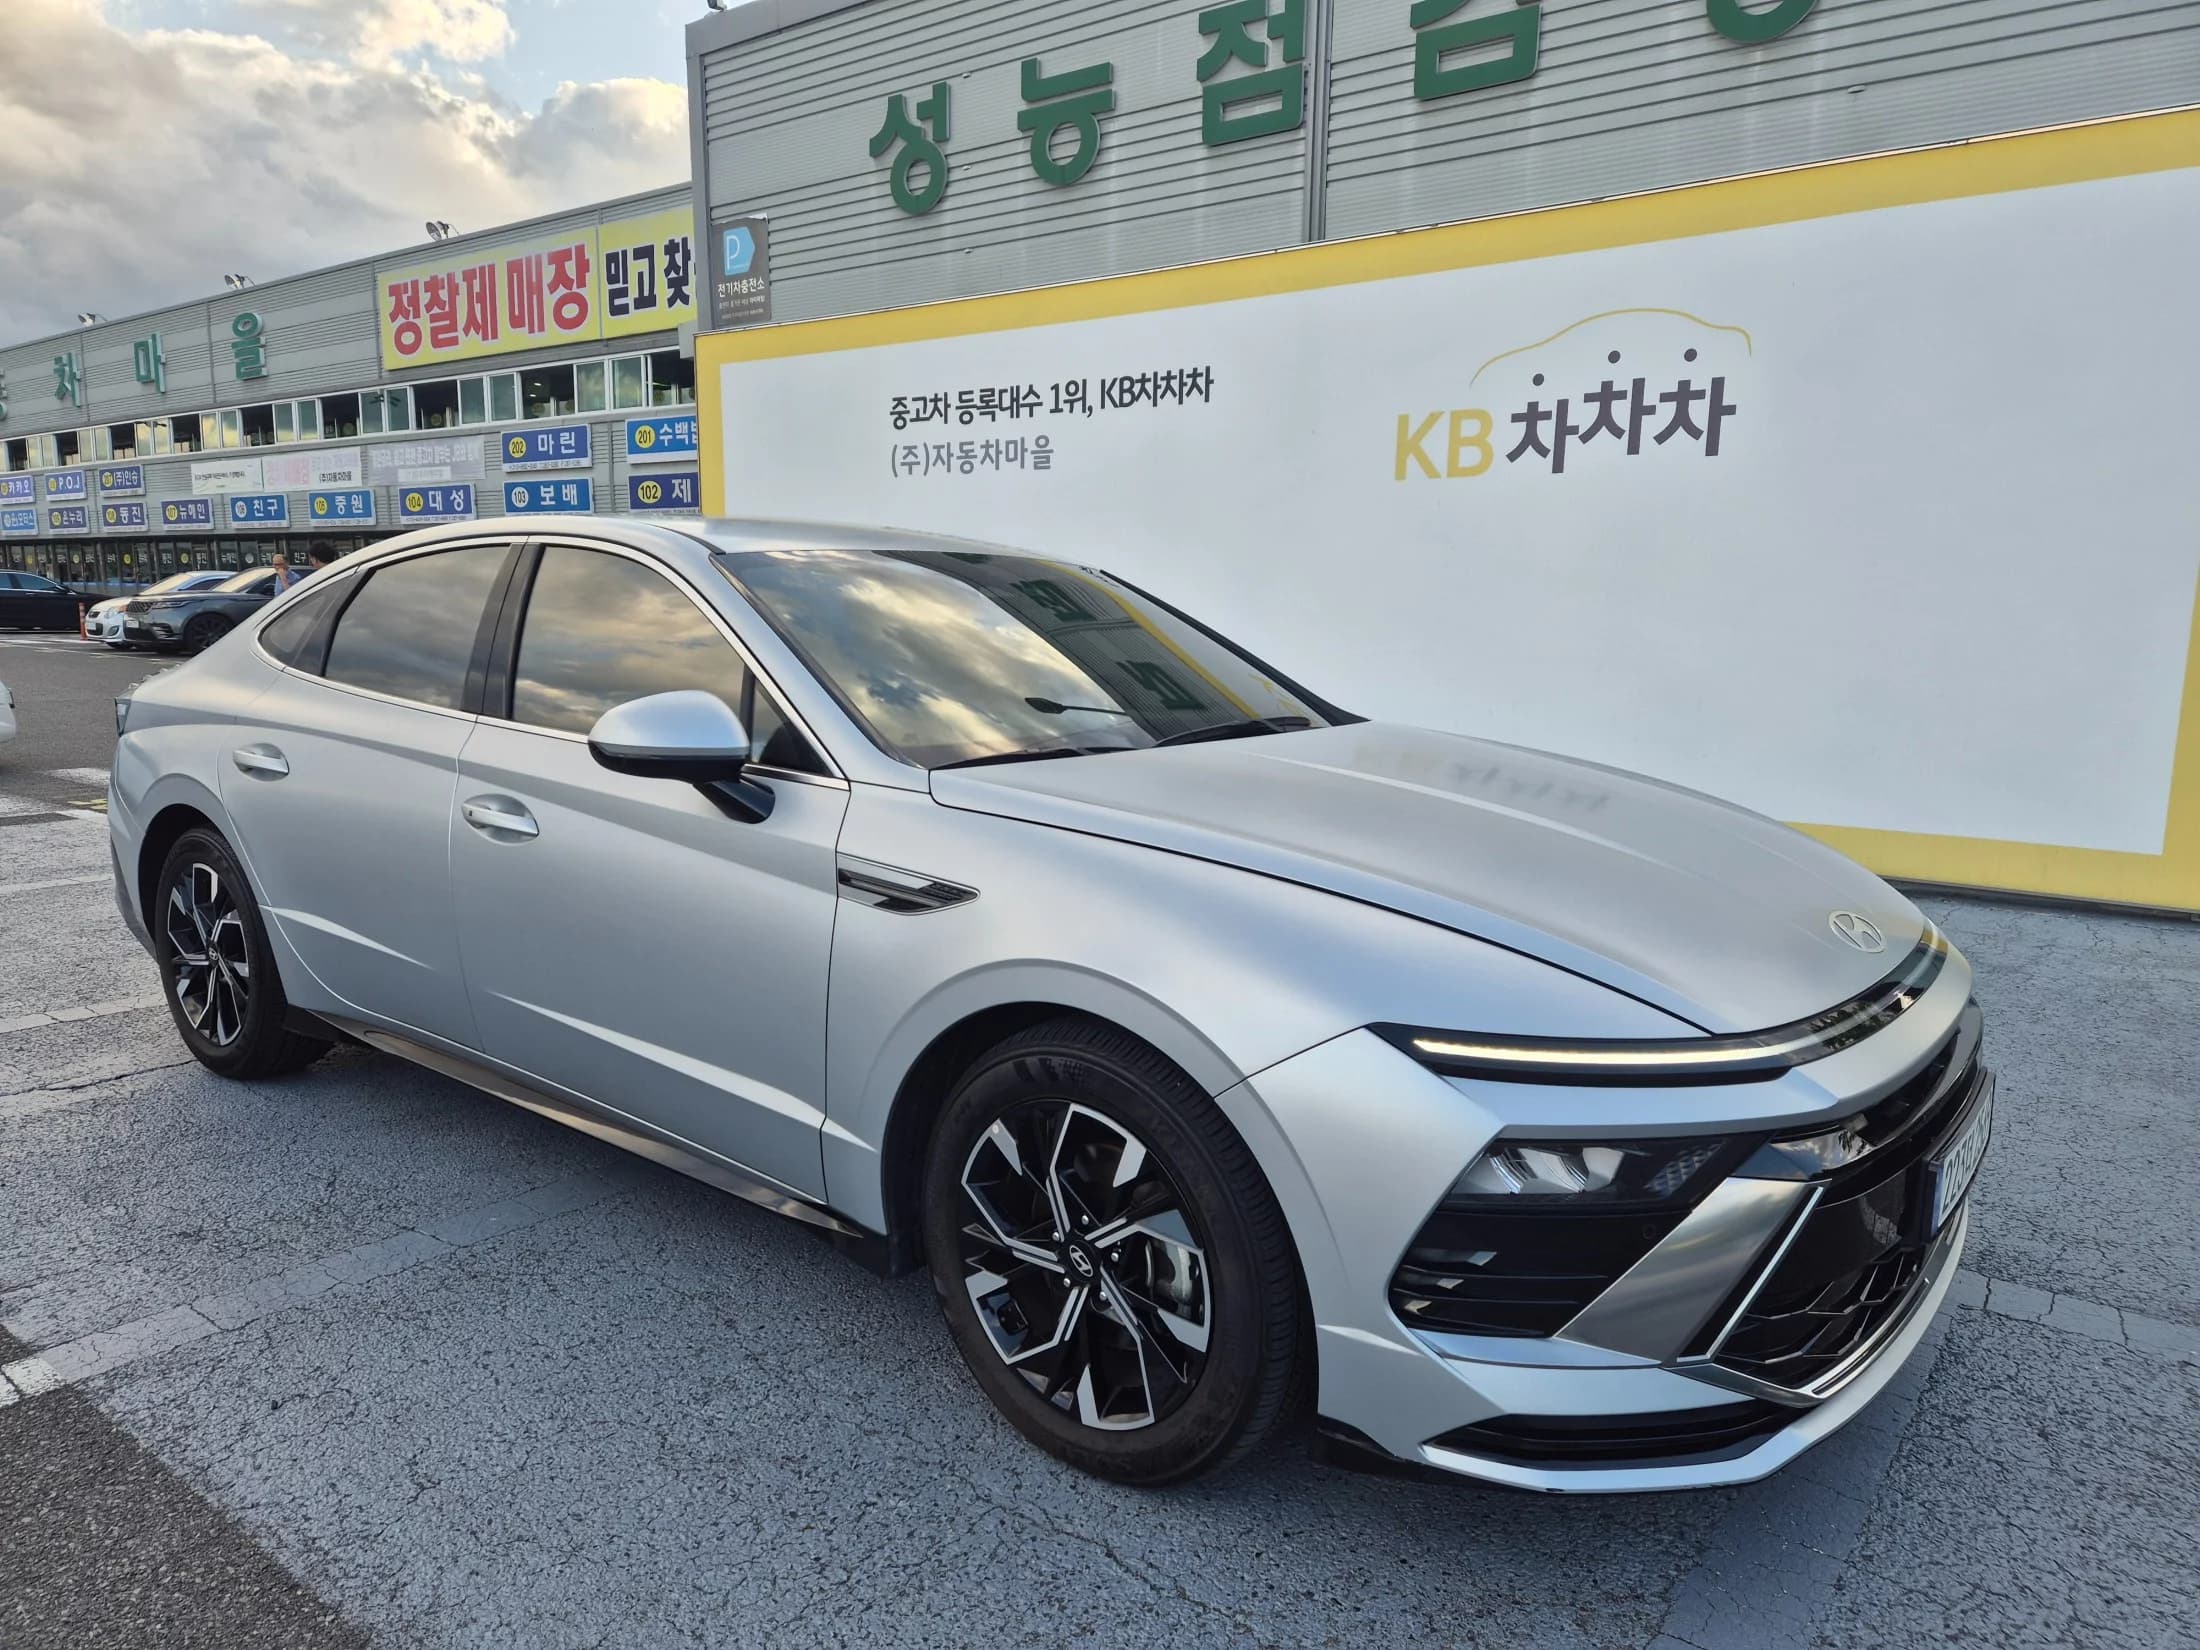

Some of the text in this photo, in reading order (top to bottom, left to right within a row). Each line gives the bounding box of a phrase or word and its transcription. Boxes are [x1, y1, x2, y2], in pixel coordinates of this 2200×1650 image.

[605, 236, 697, 317] 믿고 찾
[718, 276, 765, 298] 전기차충전소
[388, 244, 591, 356] 정찰제 매장
[889, 366, 1214, 430] 중고차 등록대수 1위, KB차차차
[1394, 348, 1737, 481] KB 차차차
[511, 431, 576, 456] 202 마린
[638, 421, 697, 447] 201 수백
[891, 435, 1054, 478] (주)자동차마을
[408, 489, 464, 511] 104 대성
[514, 484, 578, 506] 103 보배
[640, 478, 692, 503] 102 제
[120, 506, 142, 523] 동진
[253, 499, 278, 517] 친구
